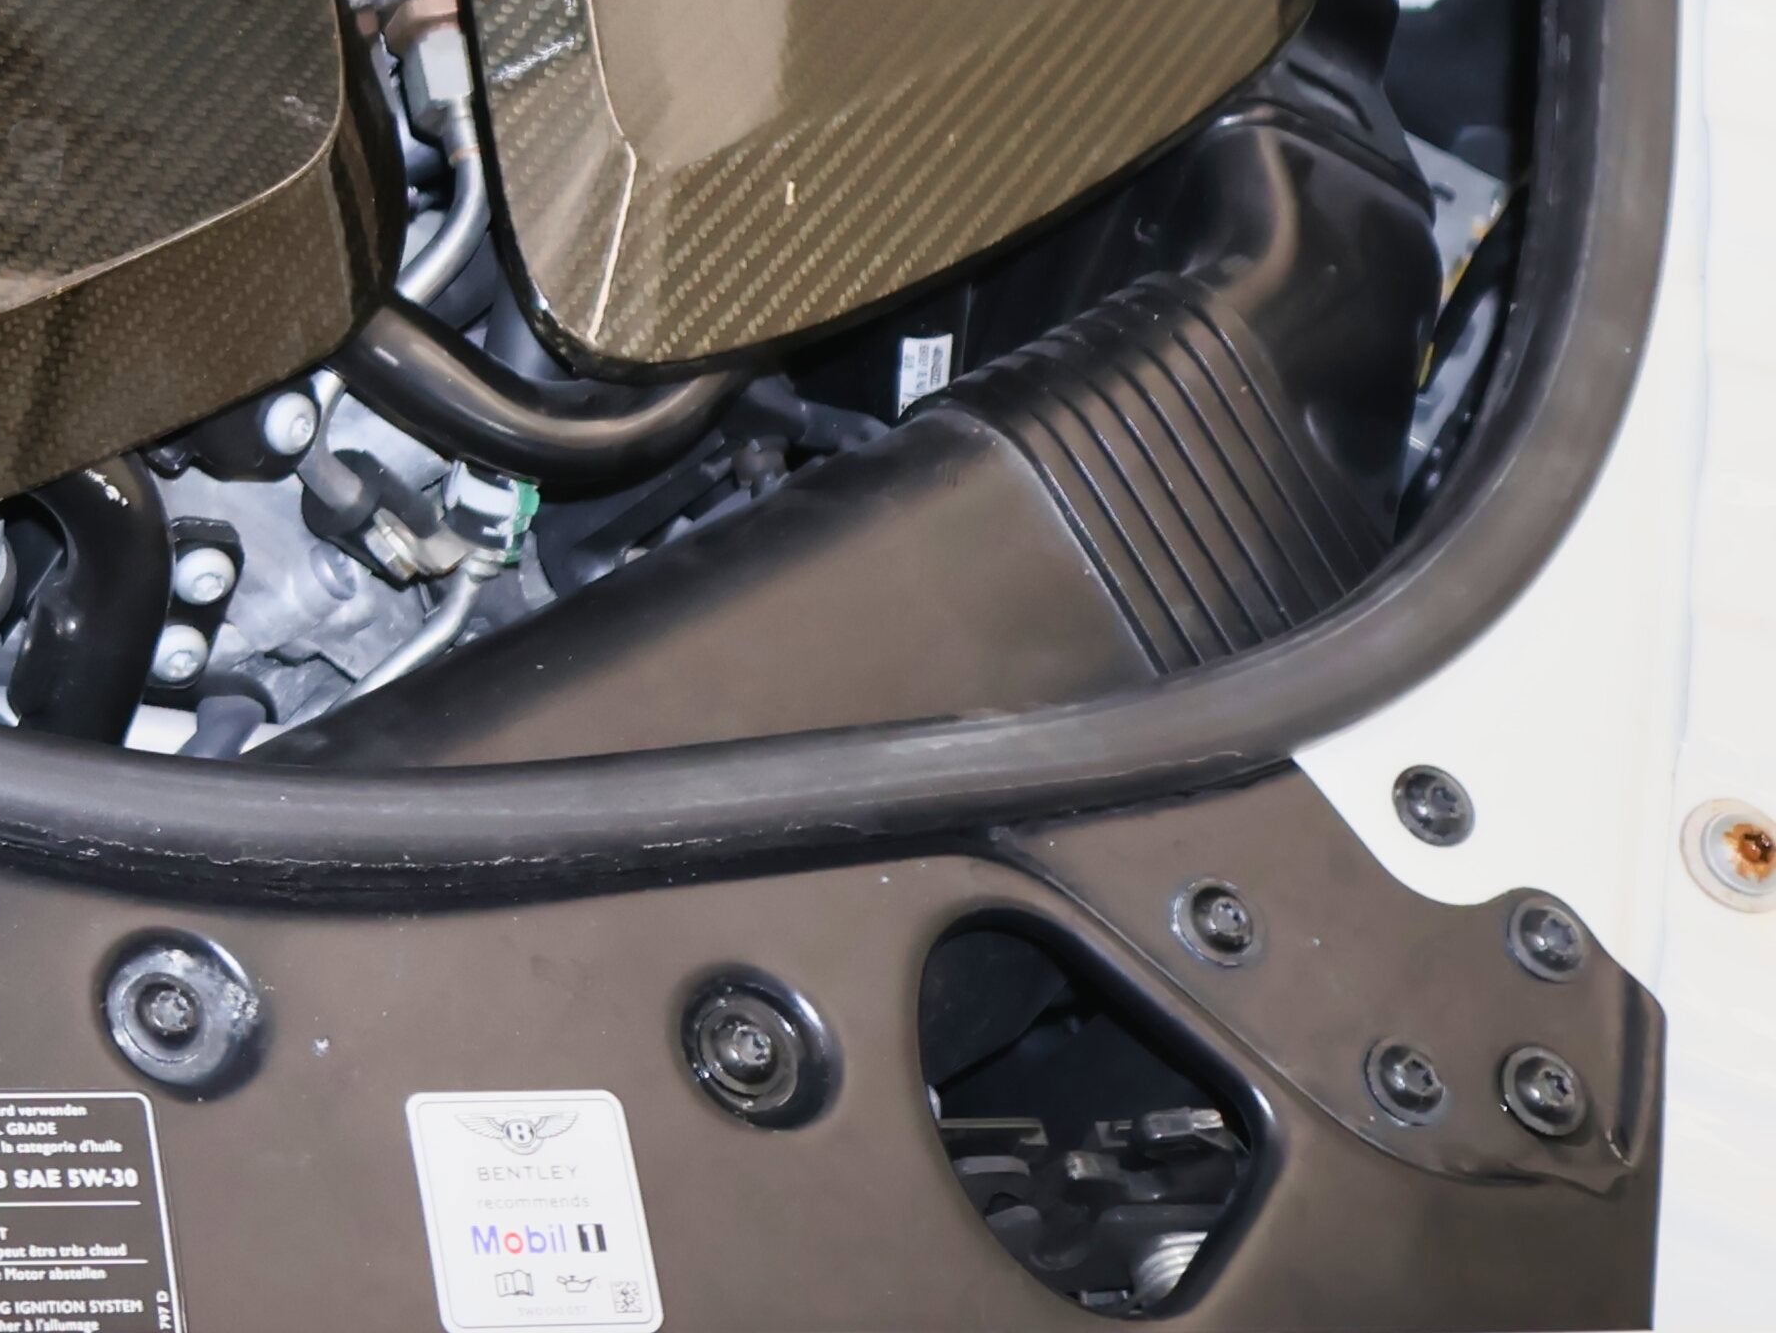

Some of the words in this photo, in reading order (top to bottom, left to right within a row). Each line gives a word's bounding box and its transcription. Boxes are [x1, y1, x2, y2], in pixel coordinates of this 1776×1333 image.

[17, 1104, 88, 1116] verwenden
[6, 1122, 58, 1136] GRADE
[1, 1140, 14, 1154] la
[13, 1168, 63, 1188] SAE
[66, 1167, 139, 1188] 5W-30
[477, 1165, 578, 1182] BENTLEY
[477, 1194, 591, 1210] recommends
[470, 1223, 567, 1254] Mobil
[88, 1243, 128, 1257] chaud
[4, 1267, 46, 1281] Motor
[48, 1266, 107, 1281] abstellen
[14, 1299, 87, 1315] IGNITION
[89, 1299, 144, 1314] SYSTEM
